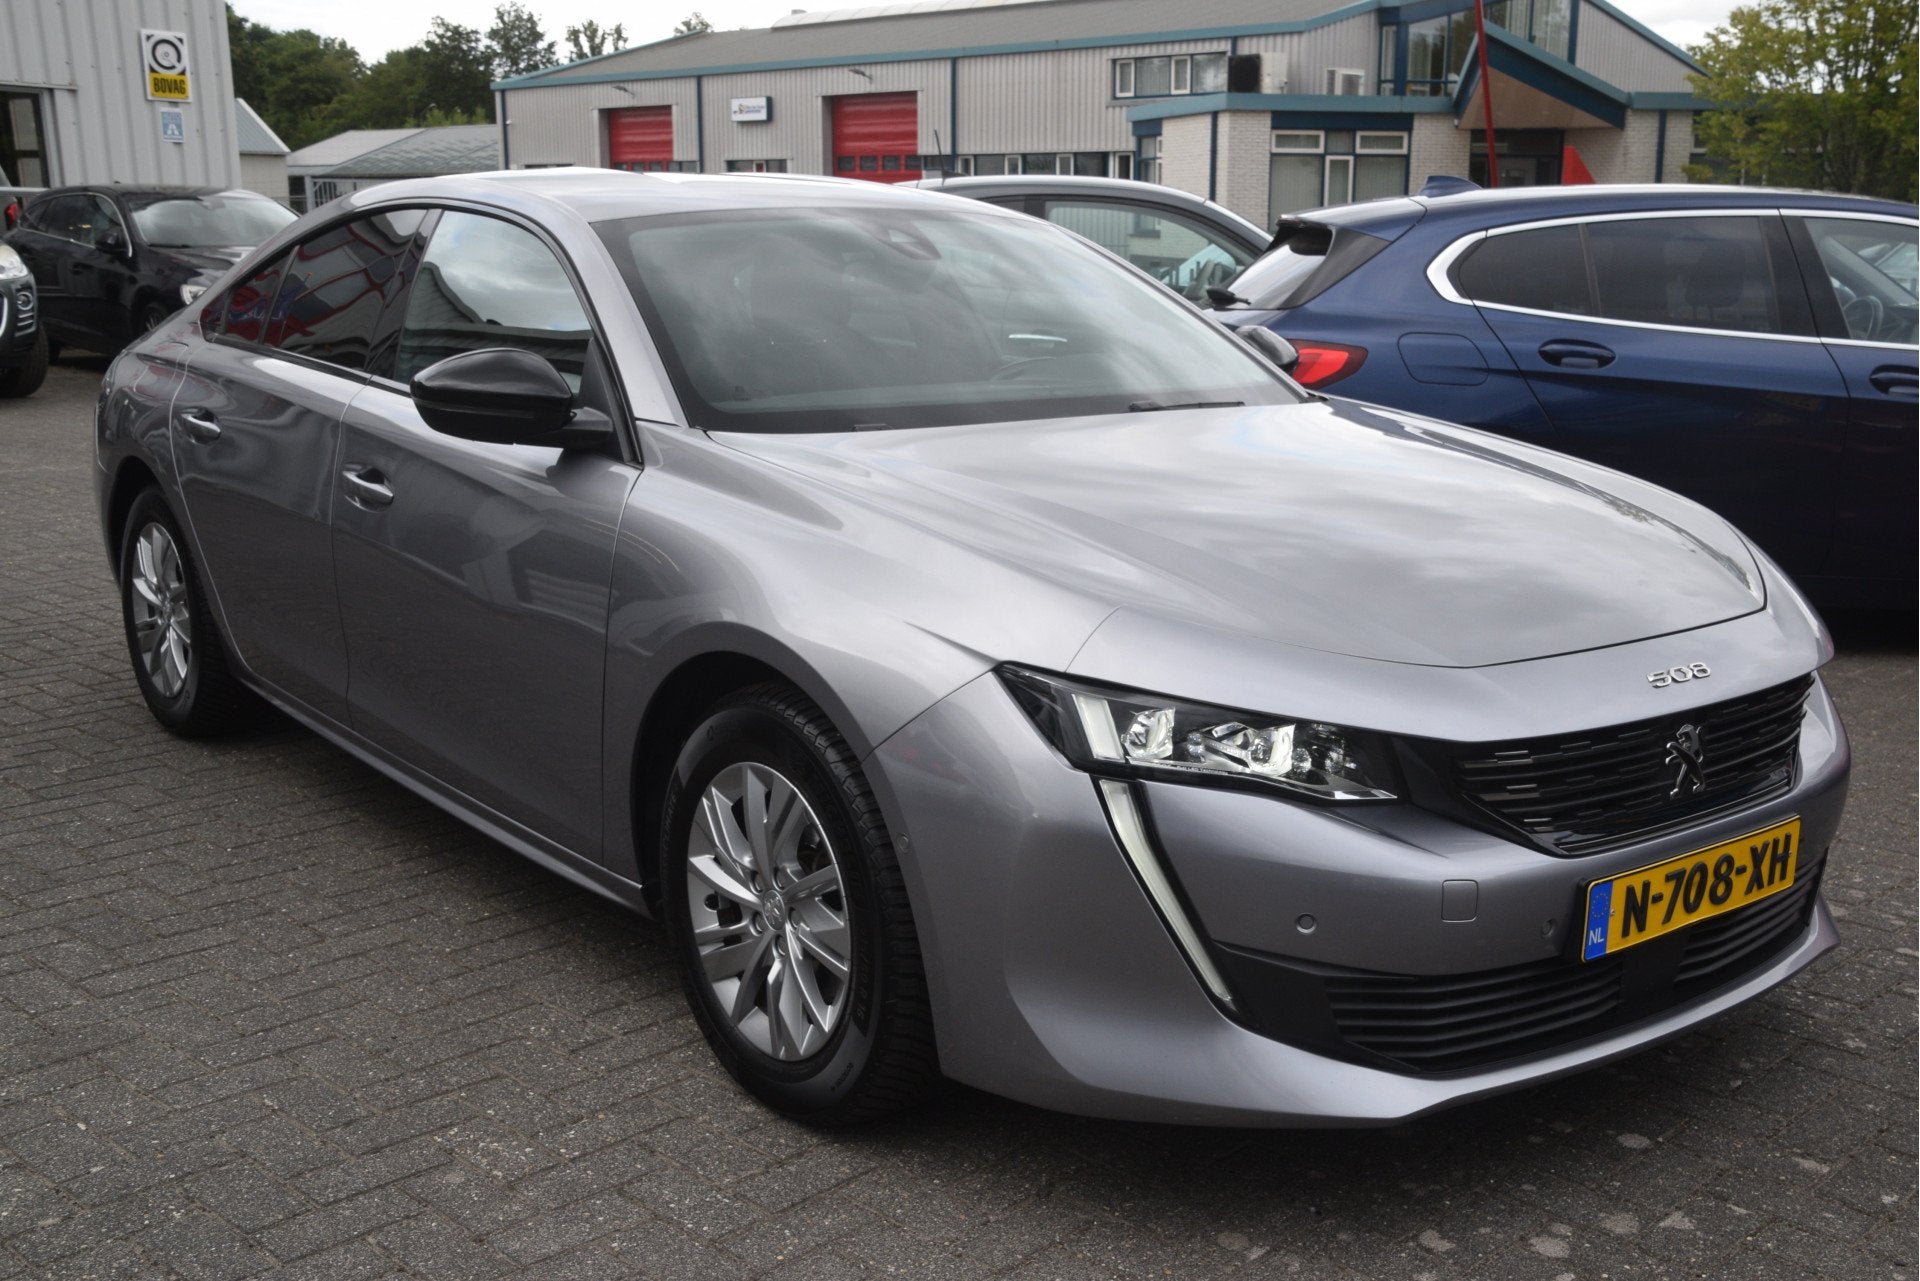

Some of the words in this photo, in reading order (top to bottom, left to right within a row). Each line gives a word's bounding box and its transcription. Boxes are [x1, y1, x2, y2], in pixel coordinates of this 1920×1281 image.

[153, 77, 186, 95] BOVAG
[1647, 662, 1711, 688] 508
[1621, 832, 1792, 938] N-708-XH
[1588, 927, 1605, 946] NL
